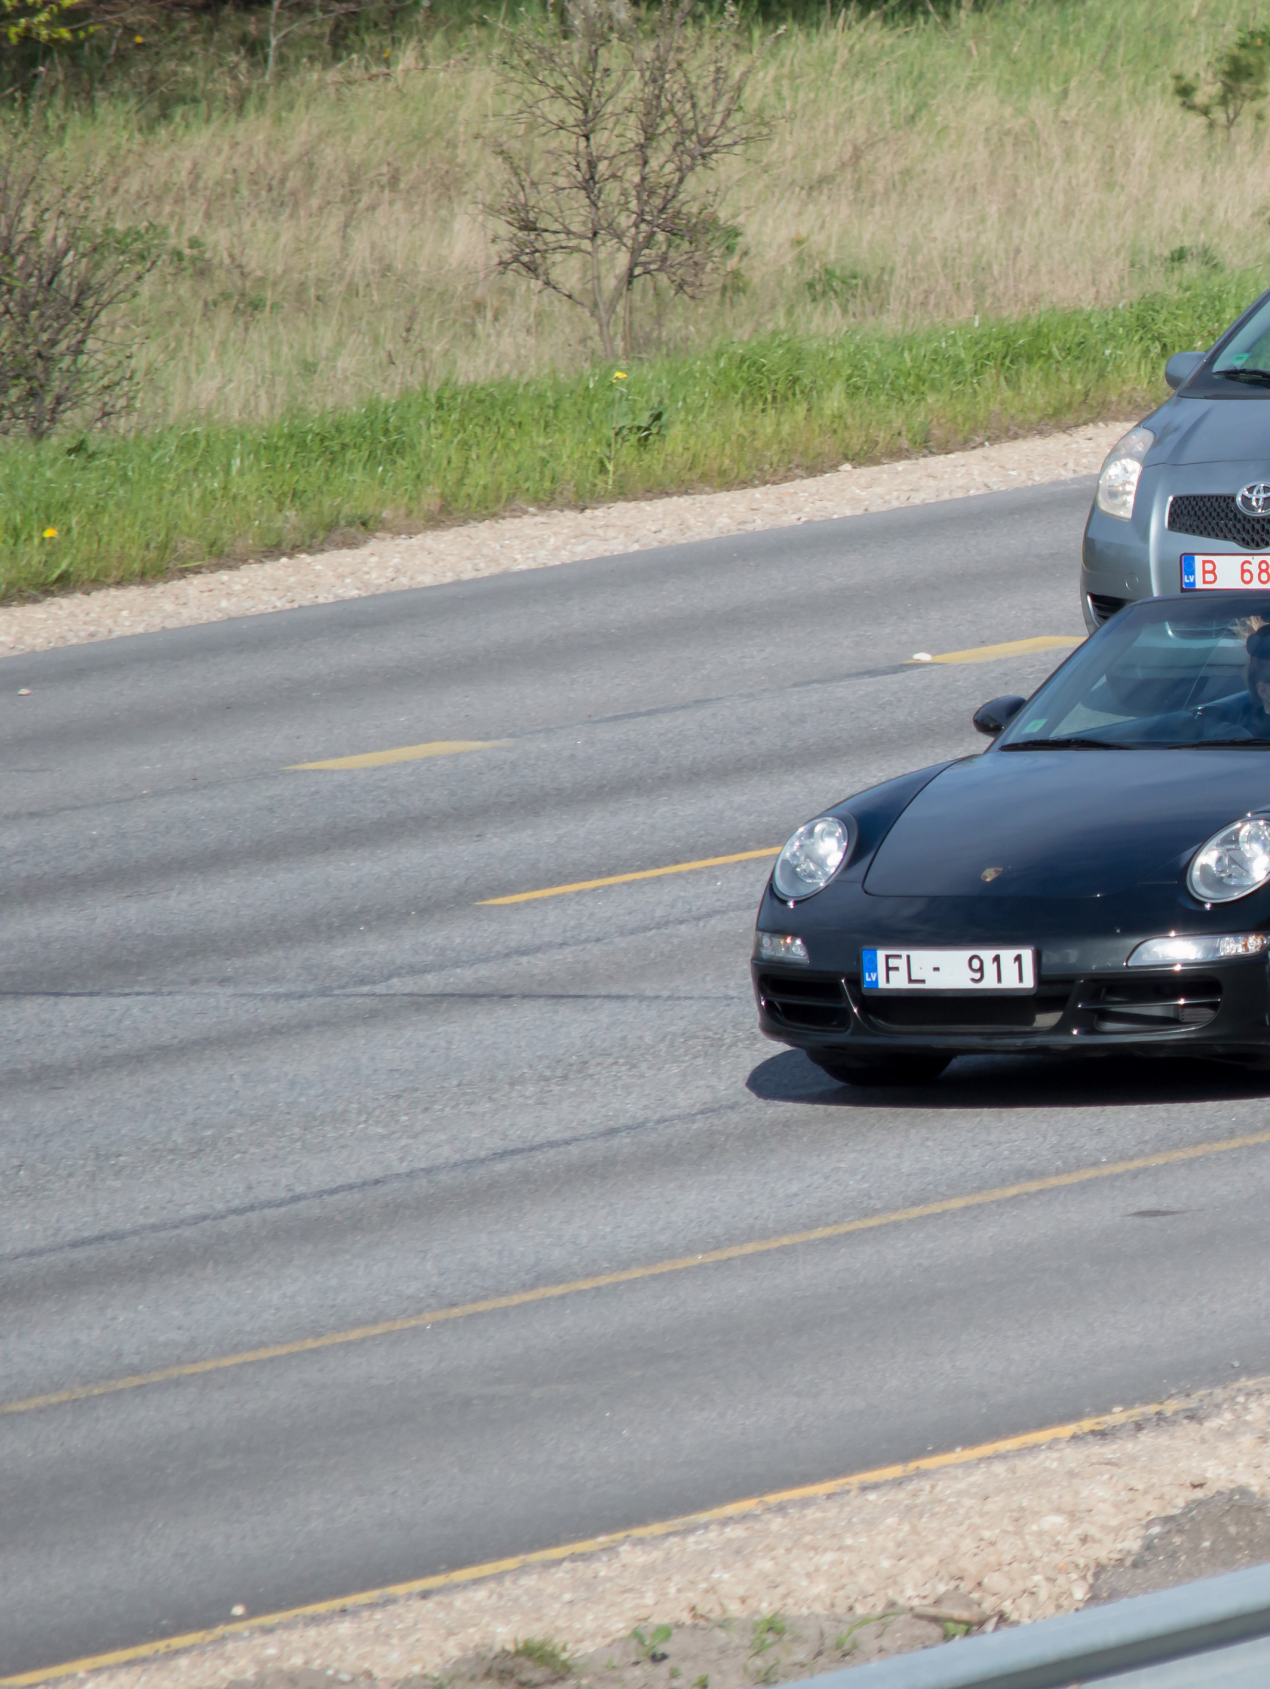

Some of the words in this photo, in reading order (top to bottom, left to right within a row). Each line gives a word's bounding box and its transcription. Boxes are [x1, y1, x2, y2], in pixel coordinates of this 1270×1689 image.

[1184, 575, 1195, 583] LV
[1201, 559, 1218, 585] B
[865, 972, 877, 982] LV
[967, 953, 1024, 984] 911
